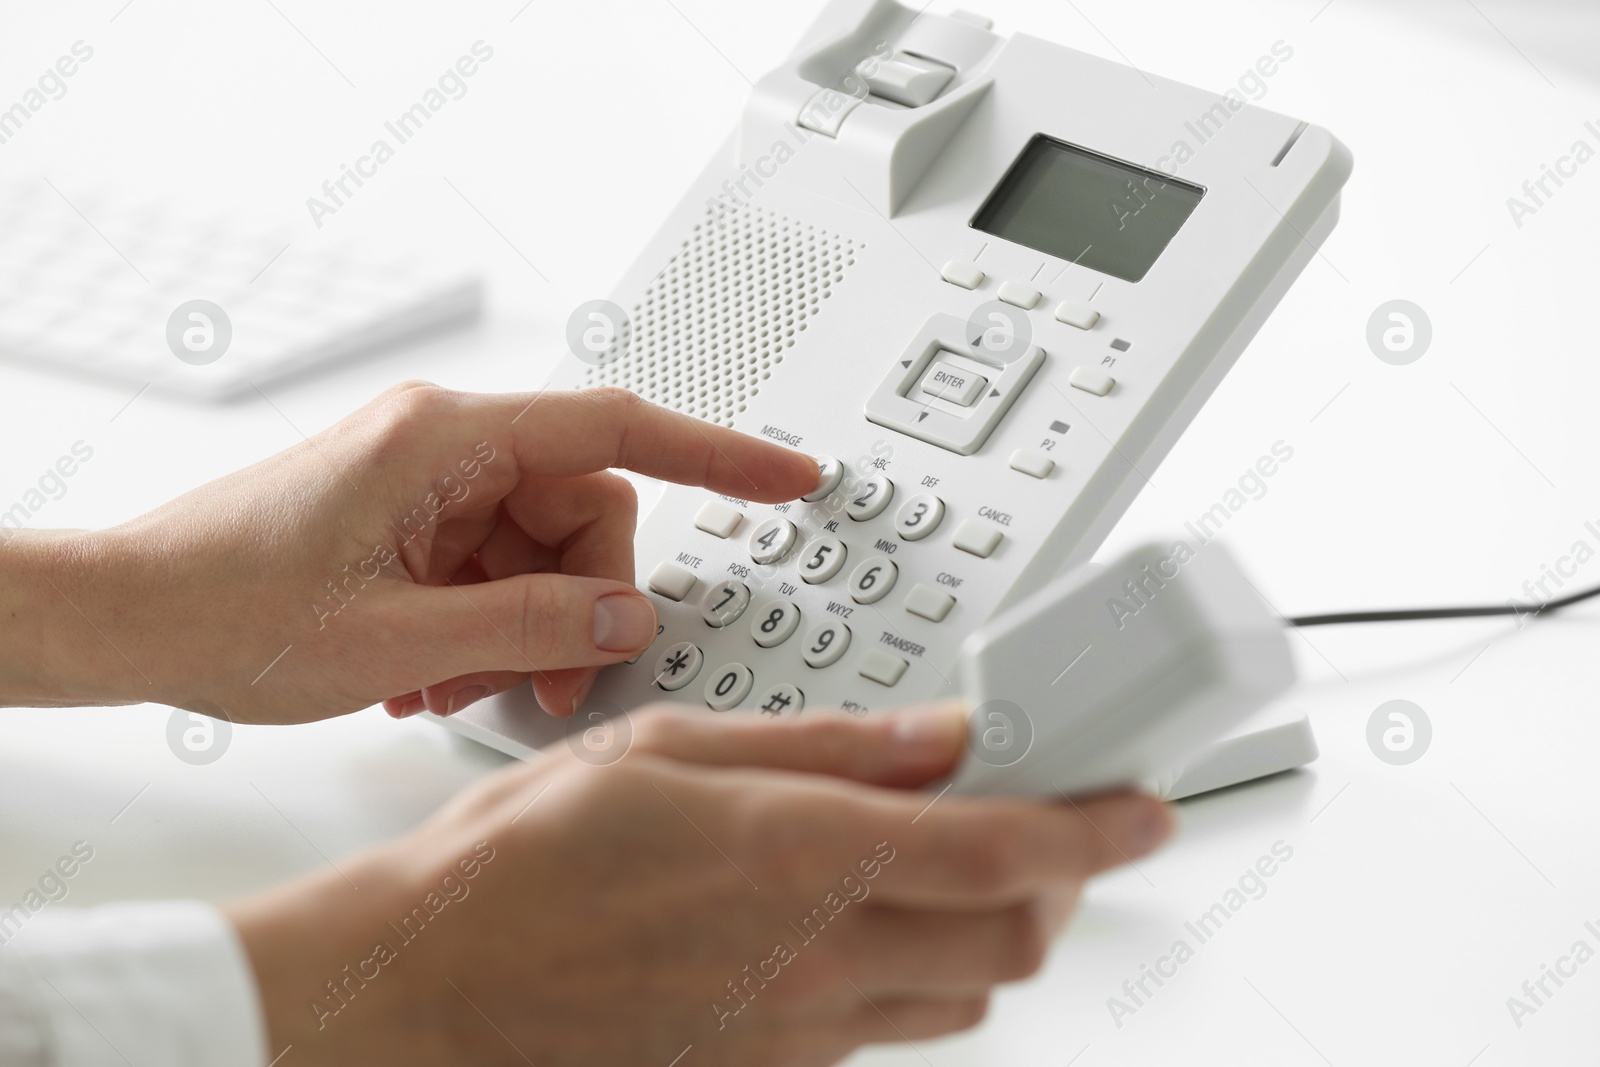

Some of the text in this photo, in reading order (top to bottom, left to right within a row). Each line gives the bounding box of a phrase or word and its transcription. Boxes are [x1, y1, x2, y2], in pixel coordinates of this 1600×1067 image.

[1101, 355, 1117, 368] P1
[933, 371, 965, 389] ENTER
[760, 424, 803, 448] MESSAGE
[1040, 438, 1056, 451] P2
[870, 457, 891, 471] ABC
[920, 475, 940, 488] DEF
[853, 482, 878, 508] 2
[774, 502, 792, 514] GHI
[904, 502, 929, 527] 3
[977, 505, 1014, 527] CANCEL
[823, 519, 840, 533] JKL
[757, 526, 782, 551] 4
[873, 538, 898, 555] MNO
[675, 551, 704, 569] MUTE
[806, 545, 832, 570] 5
[727, 562, 751, 579] PQRS
[859, 566, 882, 590] 6
[778, 582, 798, 596] TUV
[936, 572, 964, 589] CONF
[710, 588, 736, 612] 7
[826, 600, 854, 619] WXYZ
[761, 608, 784, 633] 8
[810, 629, 835, 654] 9
[879, 631, 926, 658] TRANSFER
[715, 672, 737, 697] 0
[840, 699, 869, 719] HOLD
